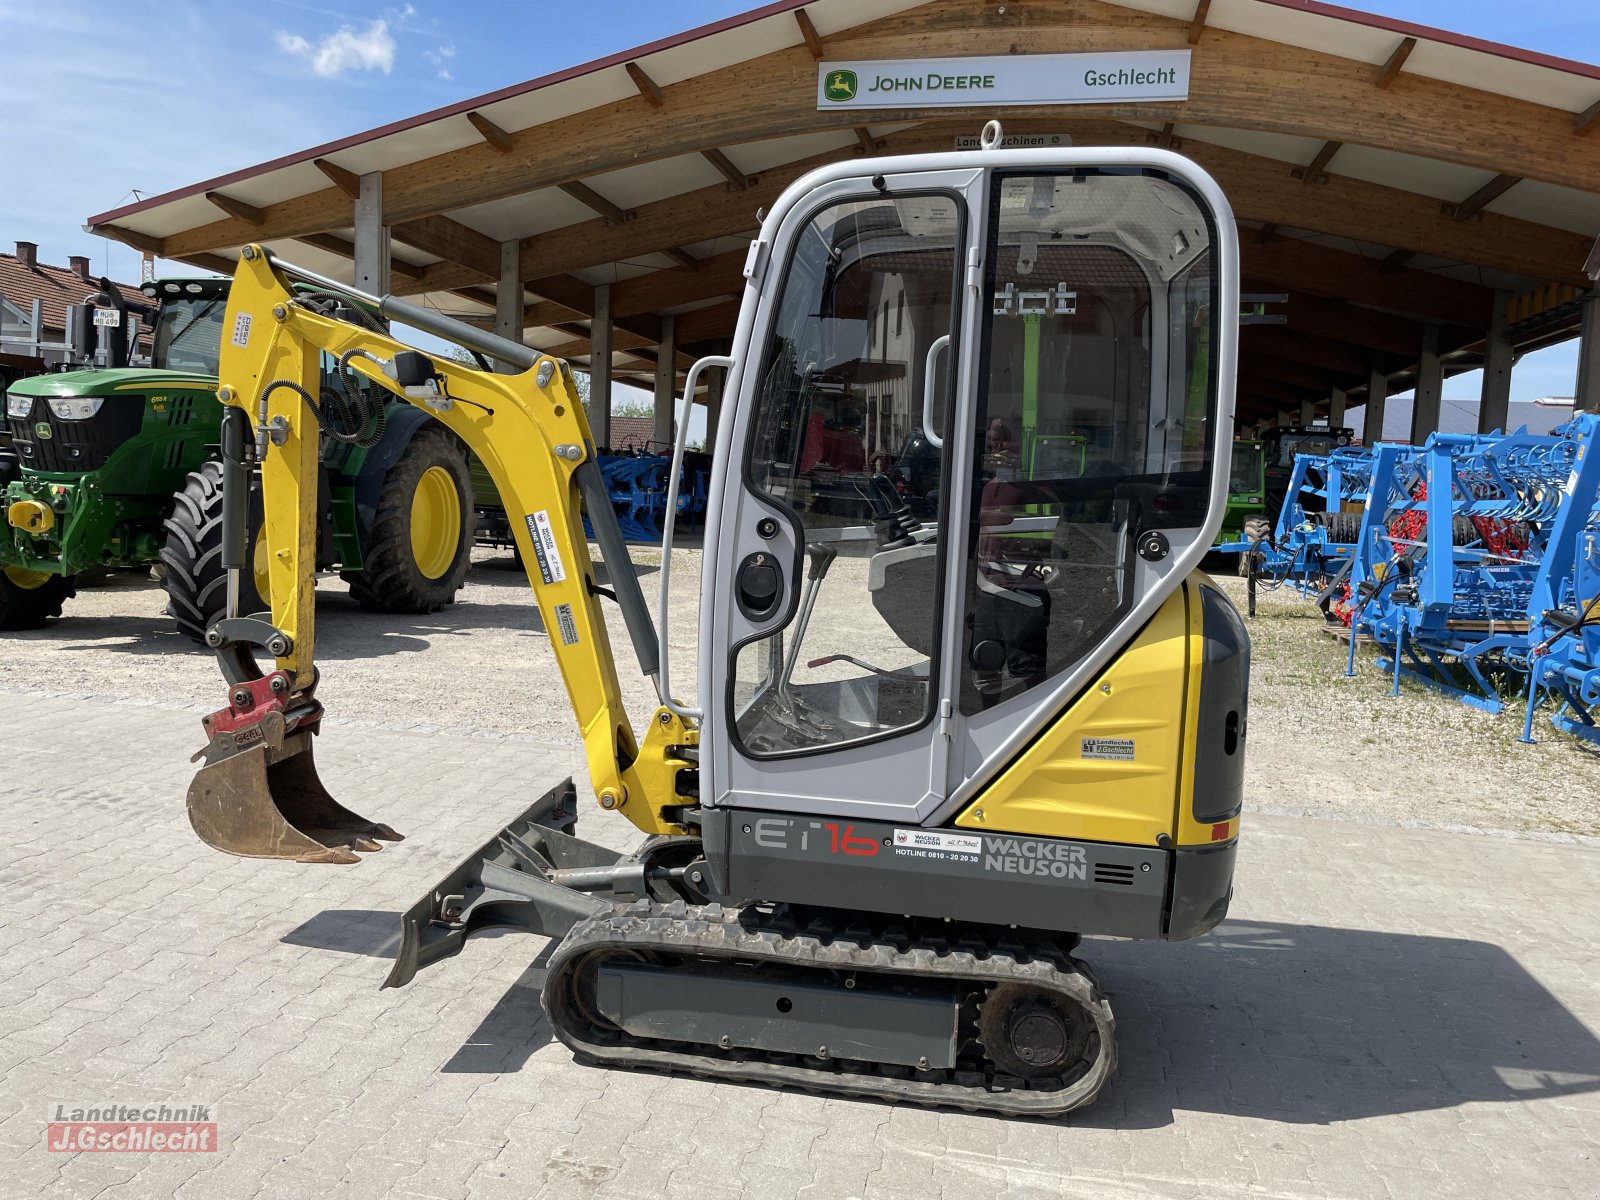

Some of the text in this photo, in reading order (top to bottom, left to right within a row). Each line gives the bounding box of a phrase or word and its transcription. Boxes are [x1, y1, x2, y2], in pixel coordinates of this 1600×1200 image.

[868, 67, 1176, 92] JOHN DEERE Gschlecht
[957, 136, 1044, 147] Lanschinen
[526, 516, 539, 542] HOTLINE
[895, 848, 927, 858] HOTLINE
[928, 851, 945, 859] 0810
[984, 836, 1088, 864] WACKER
[984, 854, 1087, 880] NEUSON
